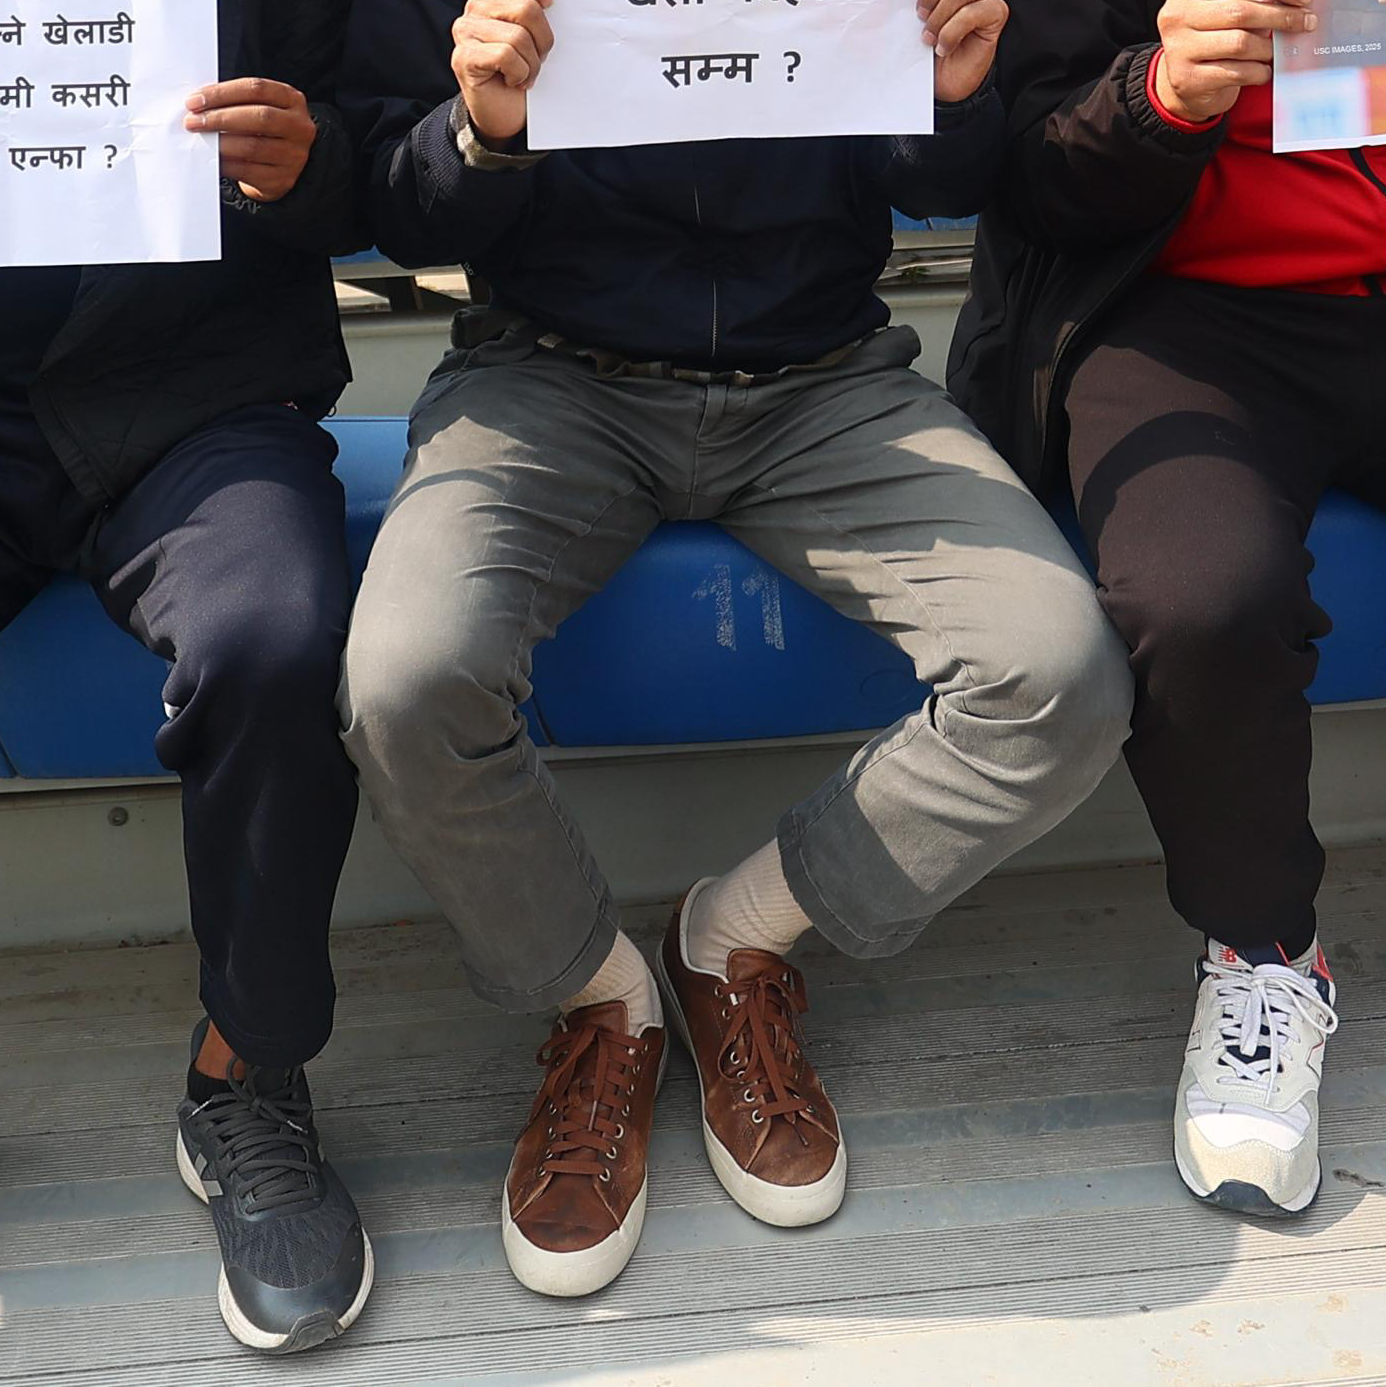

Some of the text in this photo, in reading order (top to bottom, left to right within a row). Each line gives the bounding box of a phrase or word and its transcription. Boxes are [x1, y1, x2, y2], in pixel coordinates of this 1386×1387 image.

[43, 12, 135, 44] खेलाडी
[1313, 47, 1331, 55] USC
[1332, 44, 1364, 54] IMAGES,
[661, 51, 801, 88] सम्म ?
[52, 75, 130, 107] कसरी
[9, 147, 86, 170] एन्फा
[105, 145, 117, 168] ?
